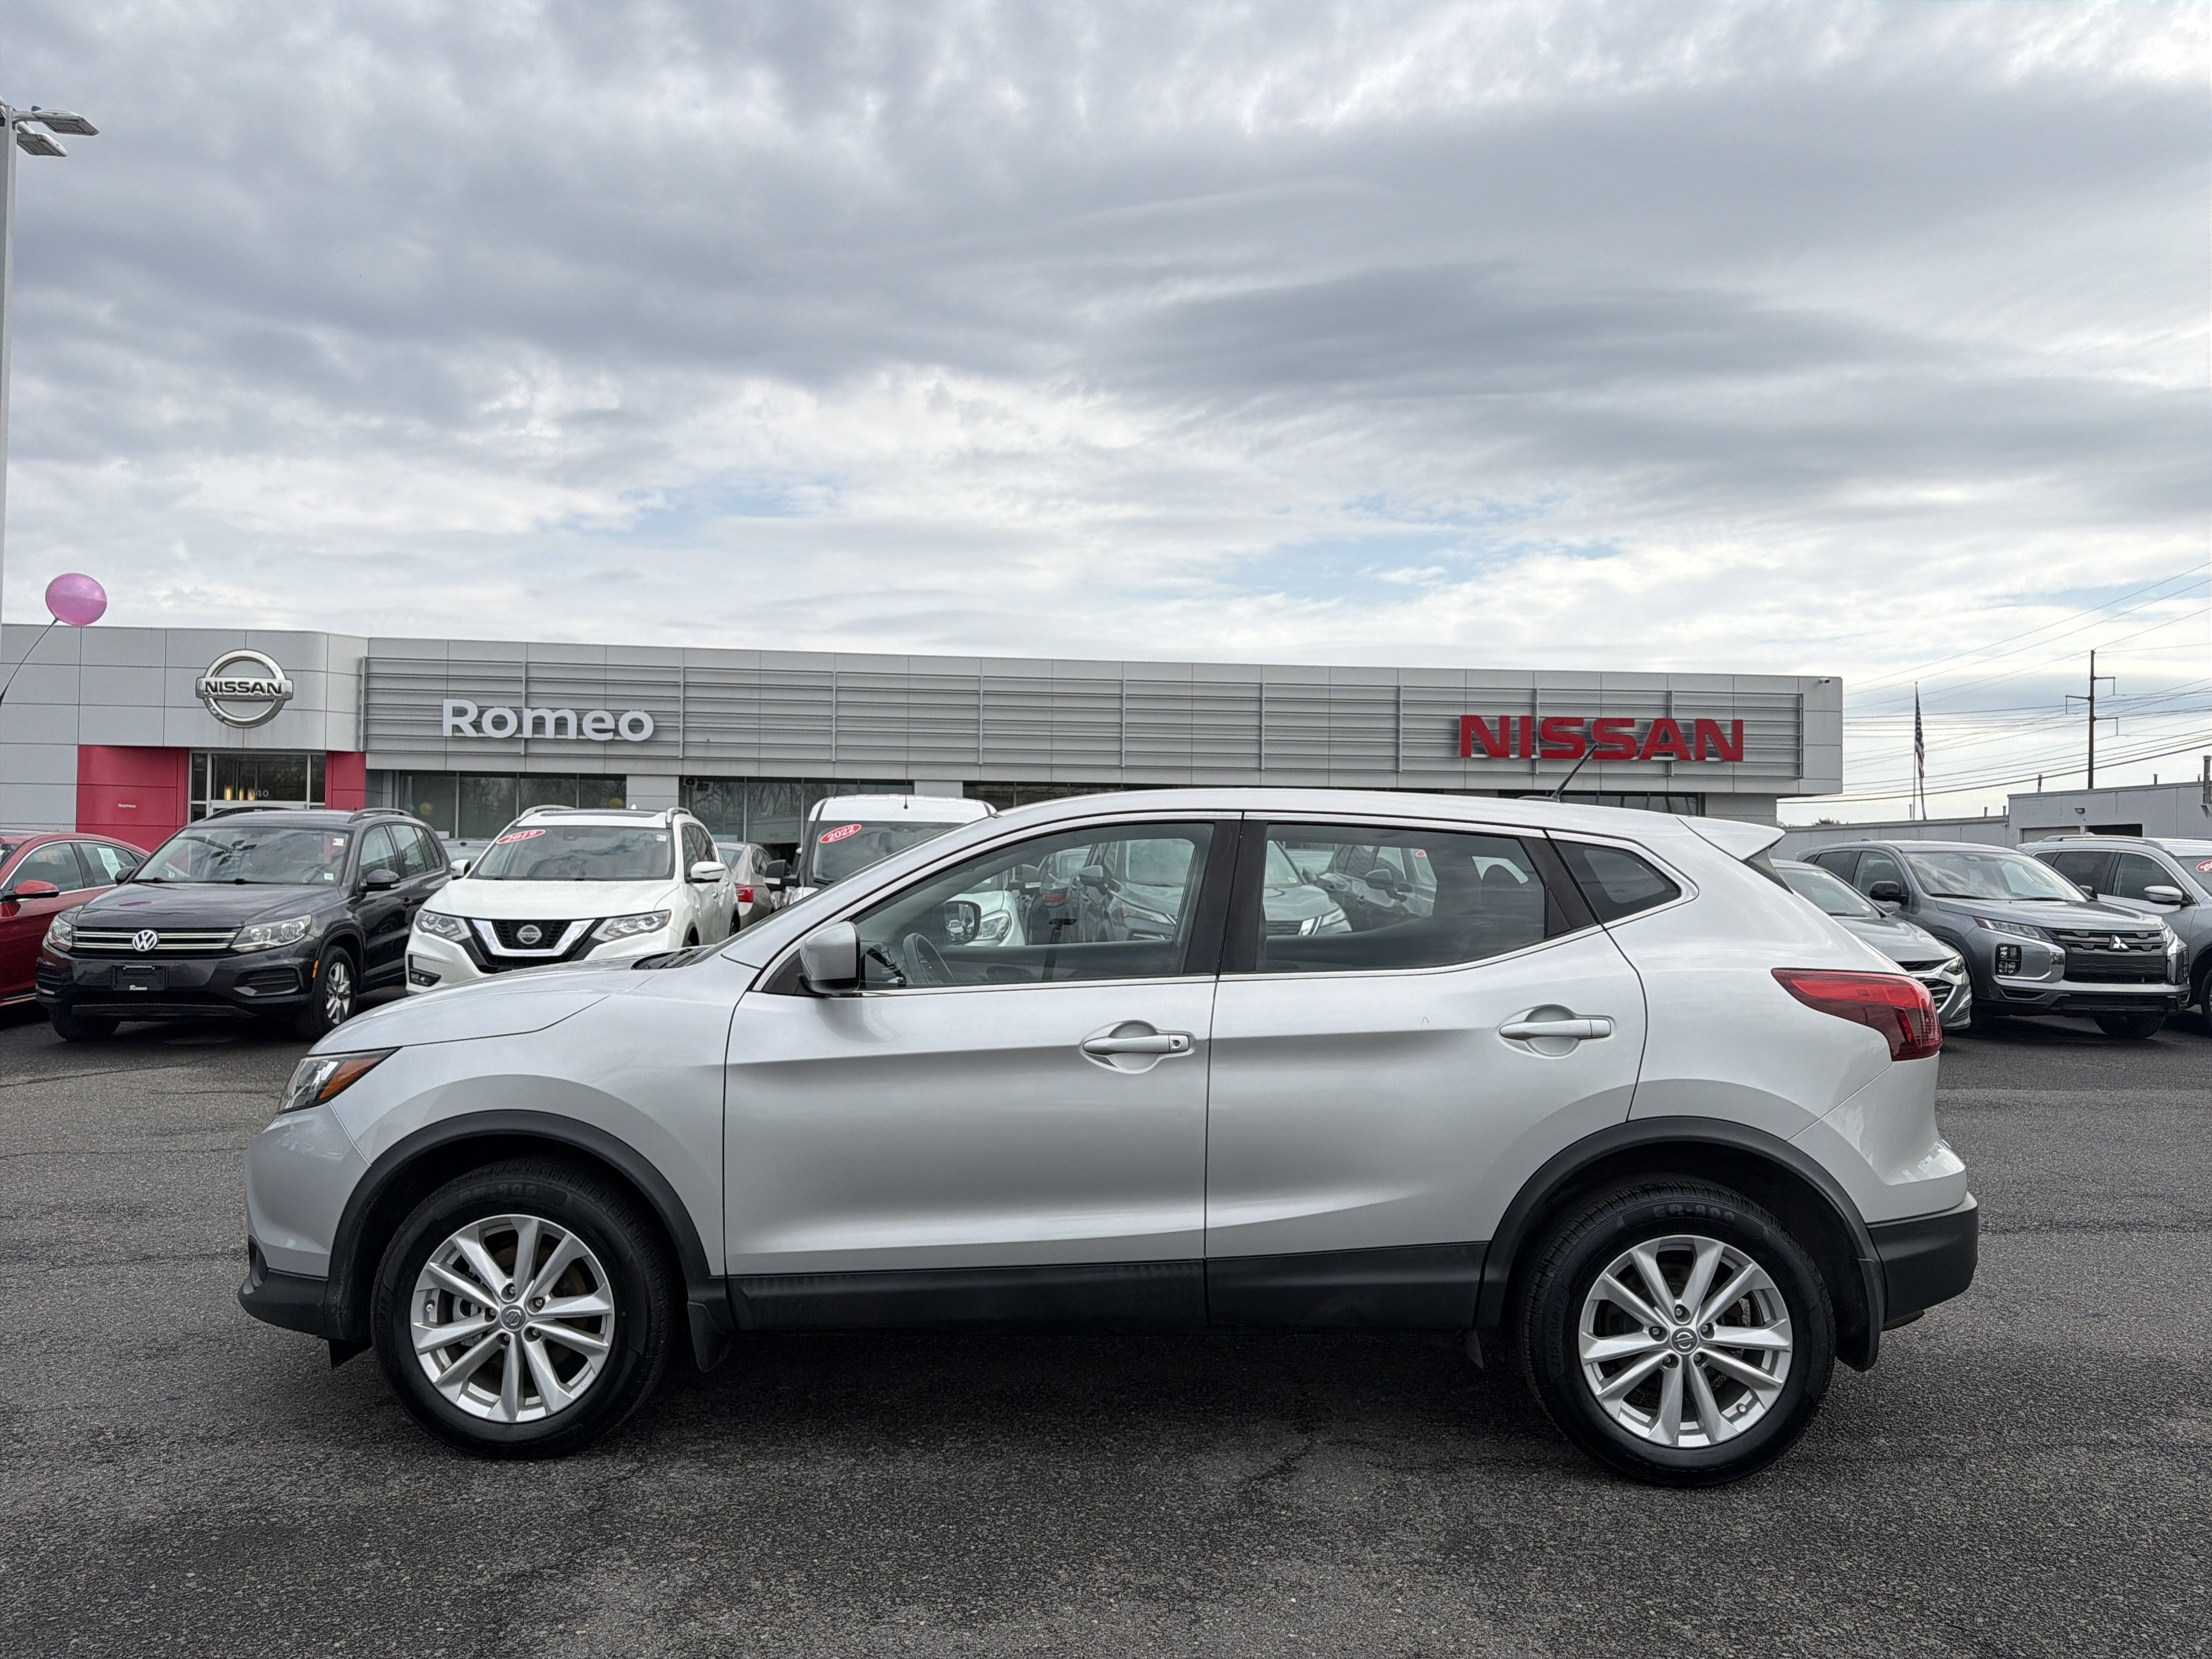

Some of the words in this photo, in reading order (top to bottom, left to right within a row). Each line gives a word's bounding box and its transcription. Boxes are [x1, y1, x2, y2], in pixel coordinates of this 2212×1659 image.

[204, 681, 282, 696] NISSAN
[443, 698, 654, 741] Romeo
[1460, 715, 1743, 762] NISSAN
[827, 825, 855, 842] 2022
[133, 930, 157, 951] VW
